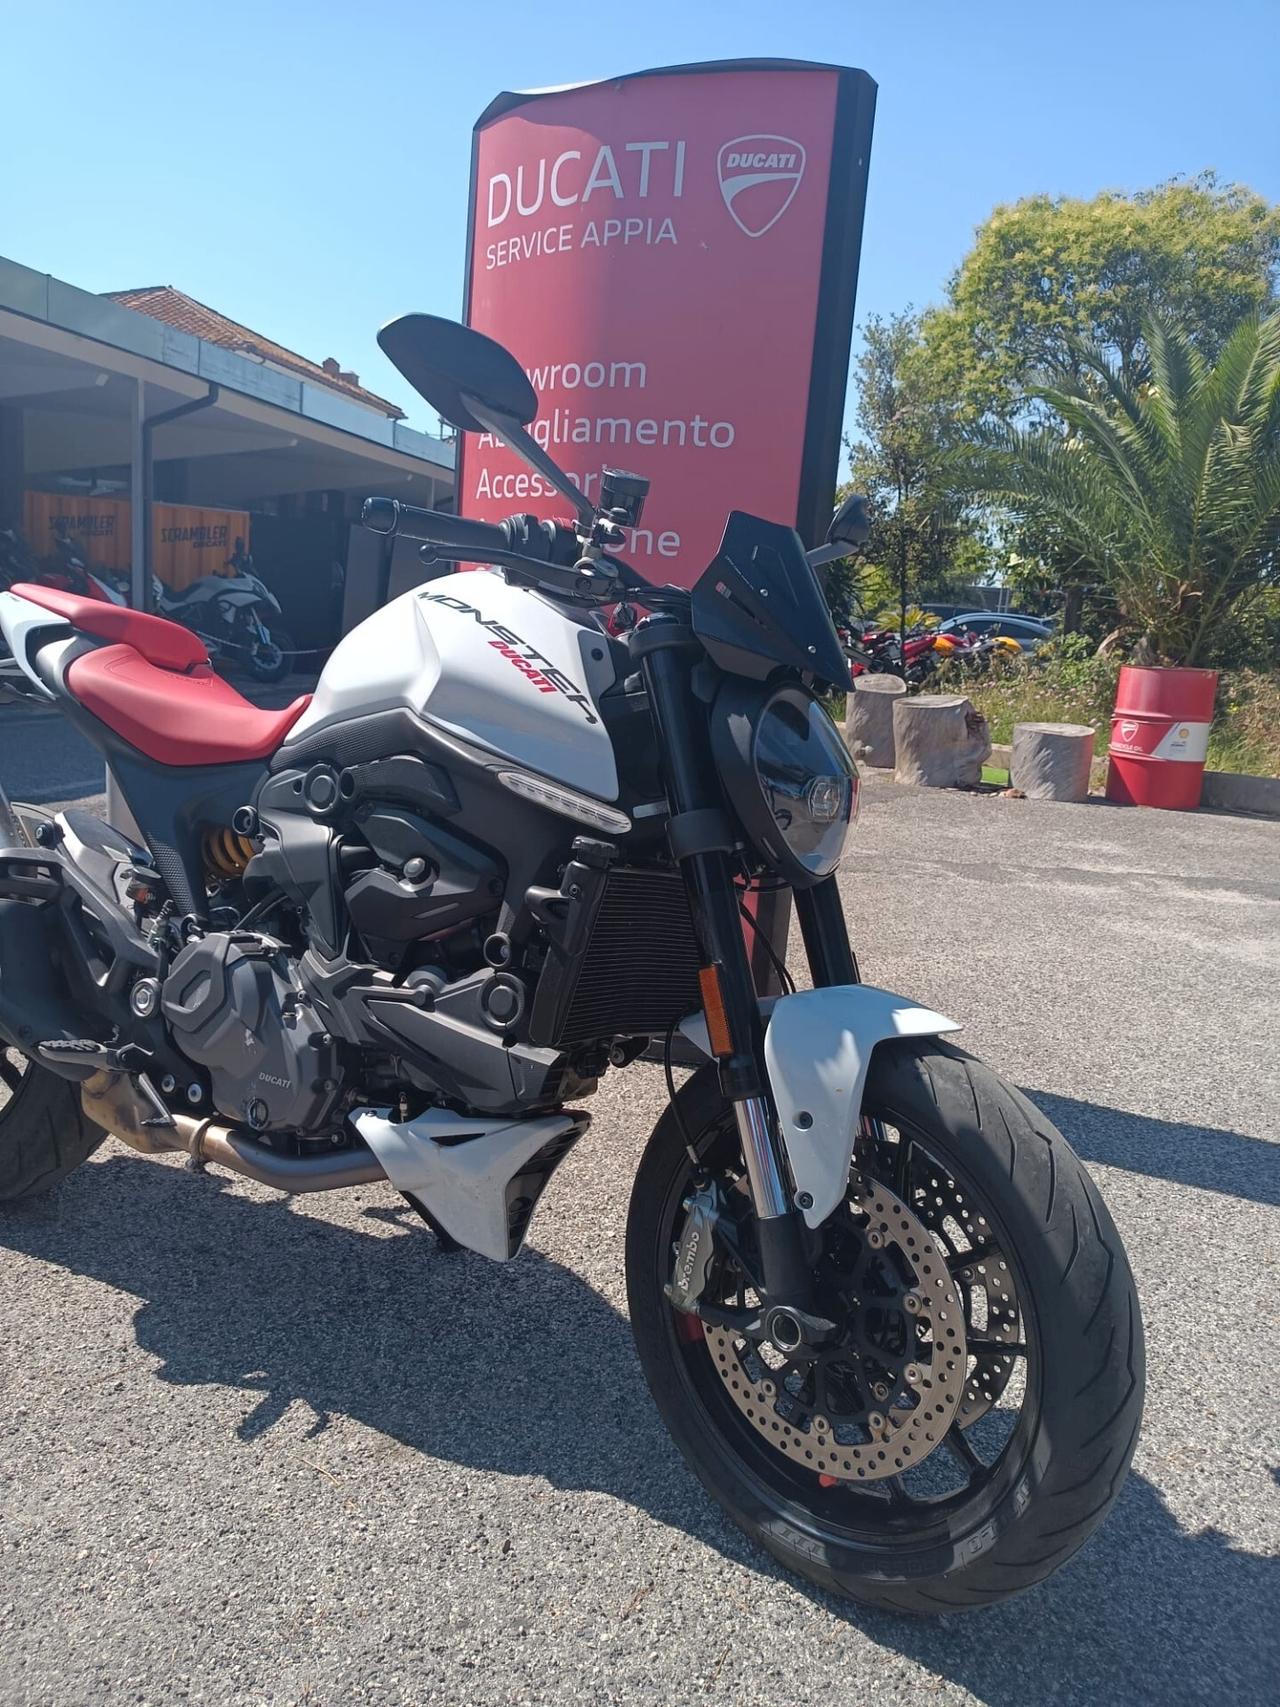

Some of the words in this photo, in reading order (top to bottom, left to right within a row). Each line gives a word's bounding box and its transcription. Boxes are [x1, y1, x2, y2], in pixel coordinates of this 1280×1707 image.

[487, 140, 687, 228] DUCATI
[726, 152, 797, 170] DUCATI
[485, 223, 574, 270] SERVICE
[580, 217, 679, 249] APPIA
[526, 360, 648, 392] wroom
[477, 407, 736, 452] Agliamento
[475, 463, 609, 499] Accessr
[416, 591, 599, 725] MONSTER
[487, 640, 558, 695] DUCATI
[258, 1071, 292, 1089] DUCATI
[677, 1230, 701, 1292] brembo
